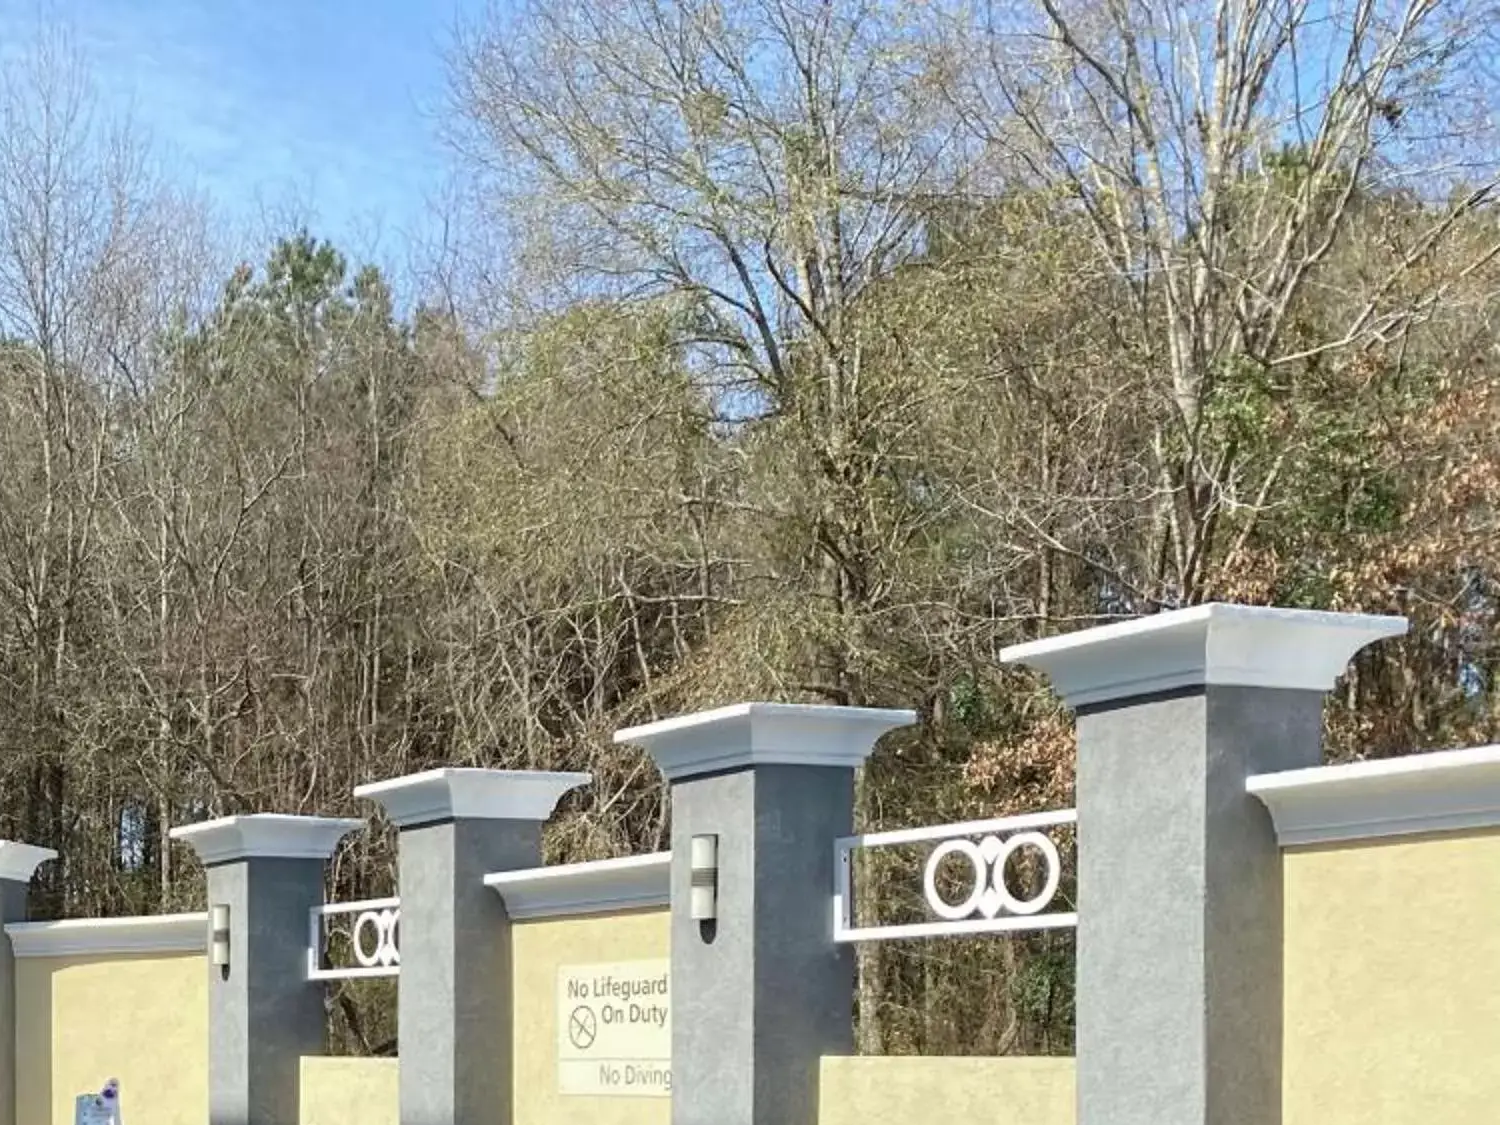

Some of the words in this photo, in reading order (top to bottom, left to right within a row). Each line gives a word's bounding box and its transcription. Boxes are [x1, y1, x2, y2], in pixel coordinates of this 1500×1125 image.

[567, 978, 589, 999] No
[594, 973, 668, 1001] Lifeguard
[601, 1004, 624, 1024] On
[629, 1004, 668, 1028] Duty
[599, 1064, 621, 1085] No
[625, 1064, 672, 1091] Diving
